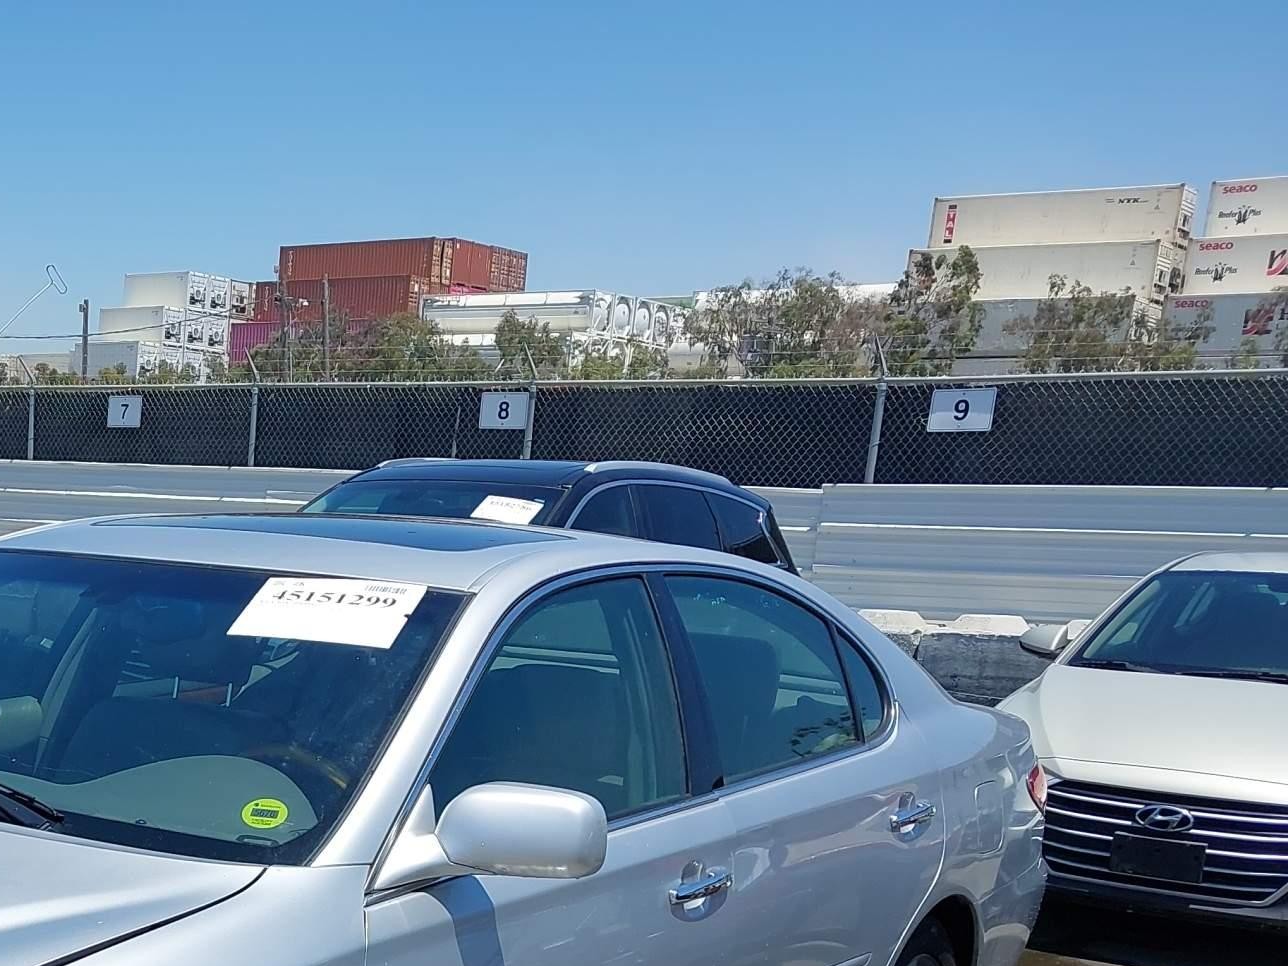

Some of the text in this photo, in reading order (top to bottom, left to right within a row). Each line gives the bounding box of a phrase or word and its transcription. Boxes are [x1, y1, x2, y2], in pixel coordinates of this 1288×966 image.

[1222, 184, 1258, 195] seaco
[1198, 240, 1234, 252] seaco
[1174, 298, 1209, 309] seaco
[121, 404, 129, 420] 7
[498, 401, 510, 420] 8
[953, 399, 970, 421] 9
[272, 590, 397, 608] 45151299
